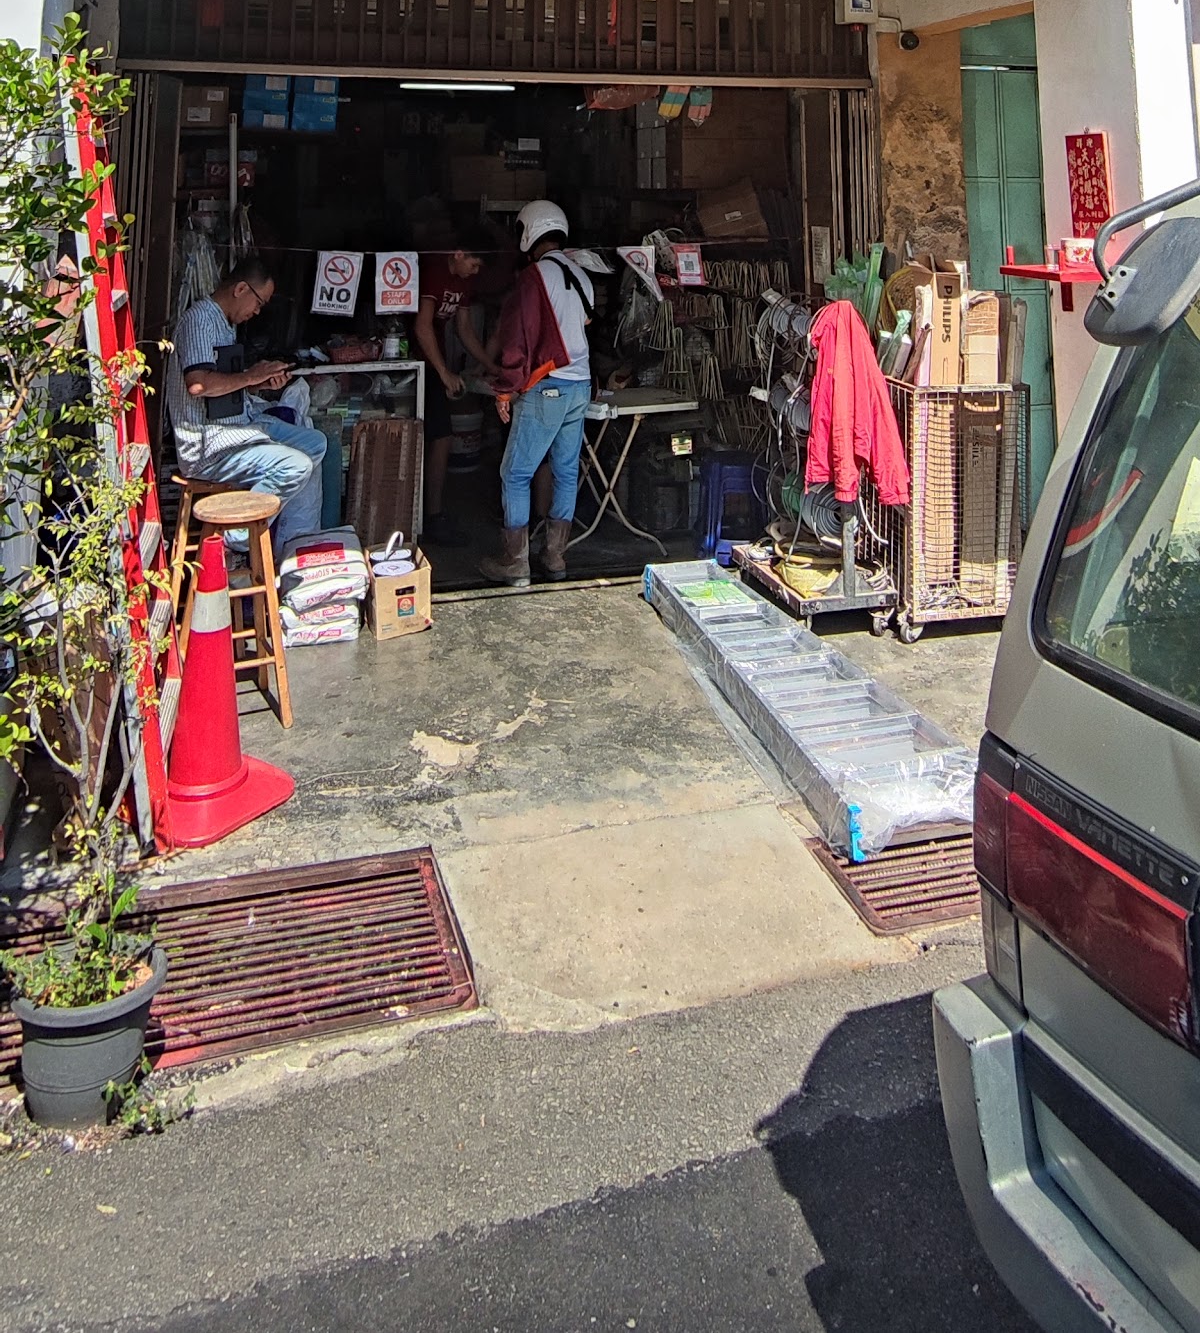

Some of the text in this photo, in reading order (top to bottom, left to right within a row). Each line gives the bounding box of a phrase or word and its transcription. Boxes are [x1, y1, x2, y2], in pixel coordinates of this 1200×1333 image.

[318, 302, 350, 311] SMOKING!
[319, 286, 351, 303] NO
[942, 285, 953, 343] PHILIPS
[1025, 774, 1176, 888] NISSAN VANETTE
